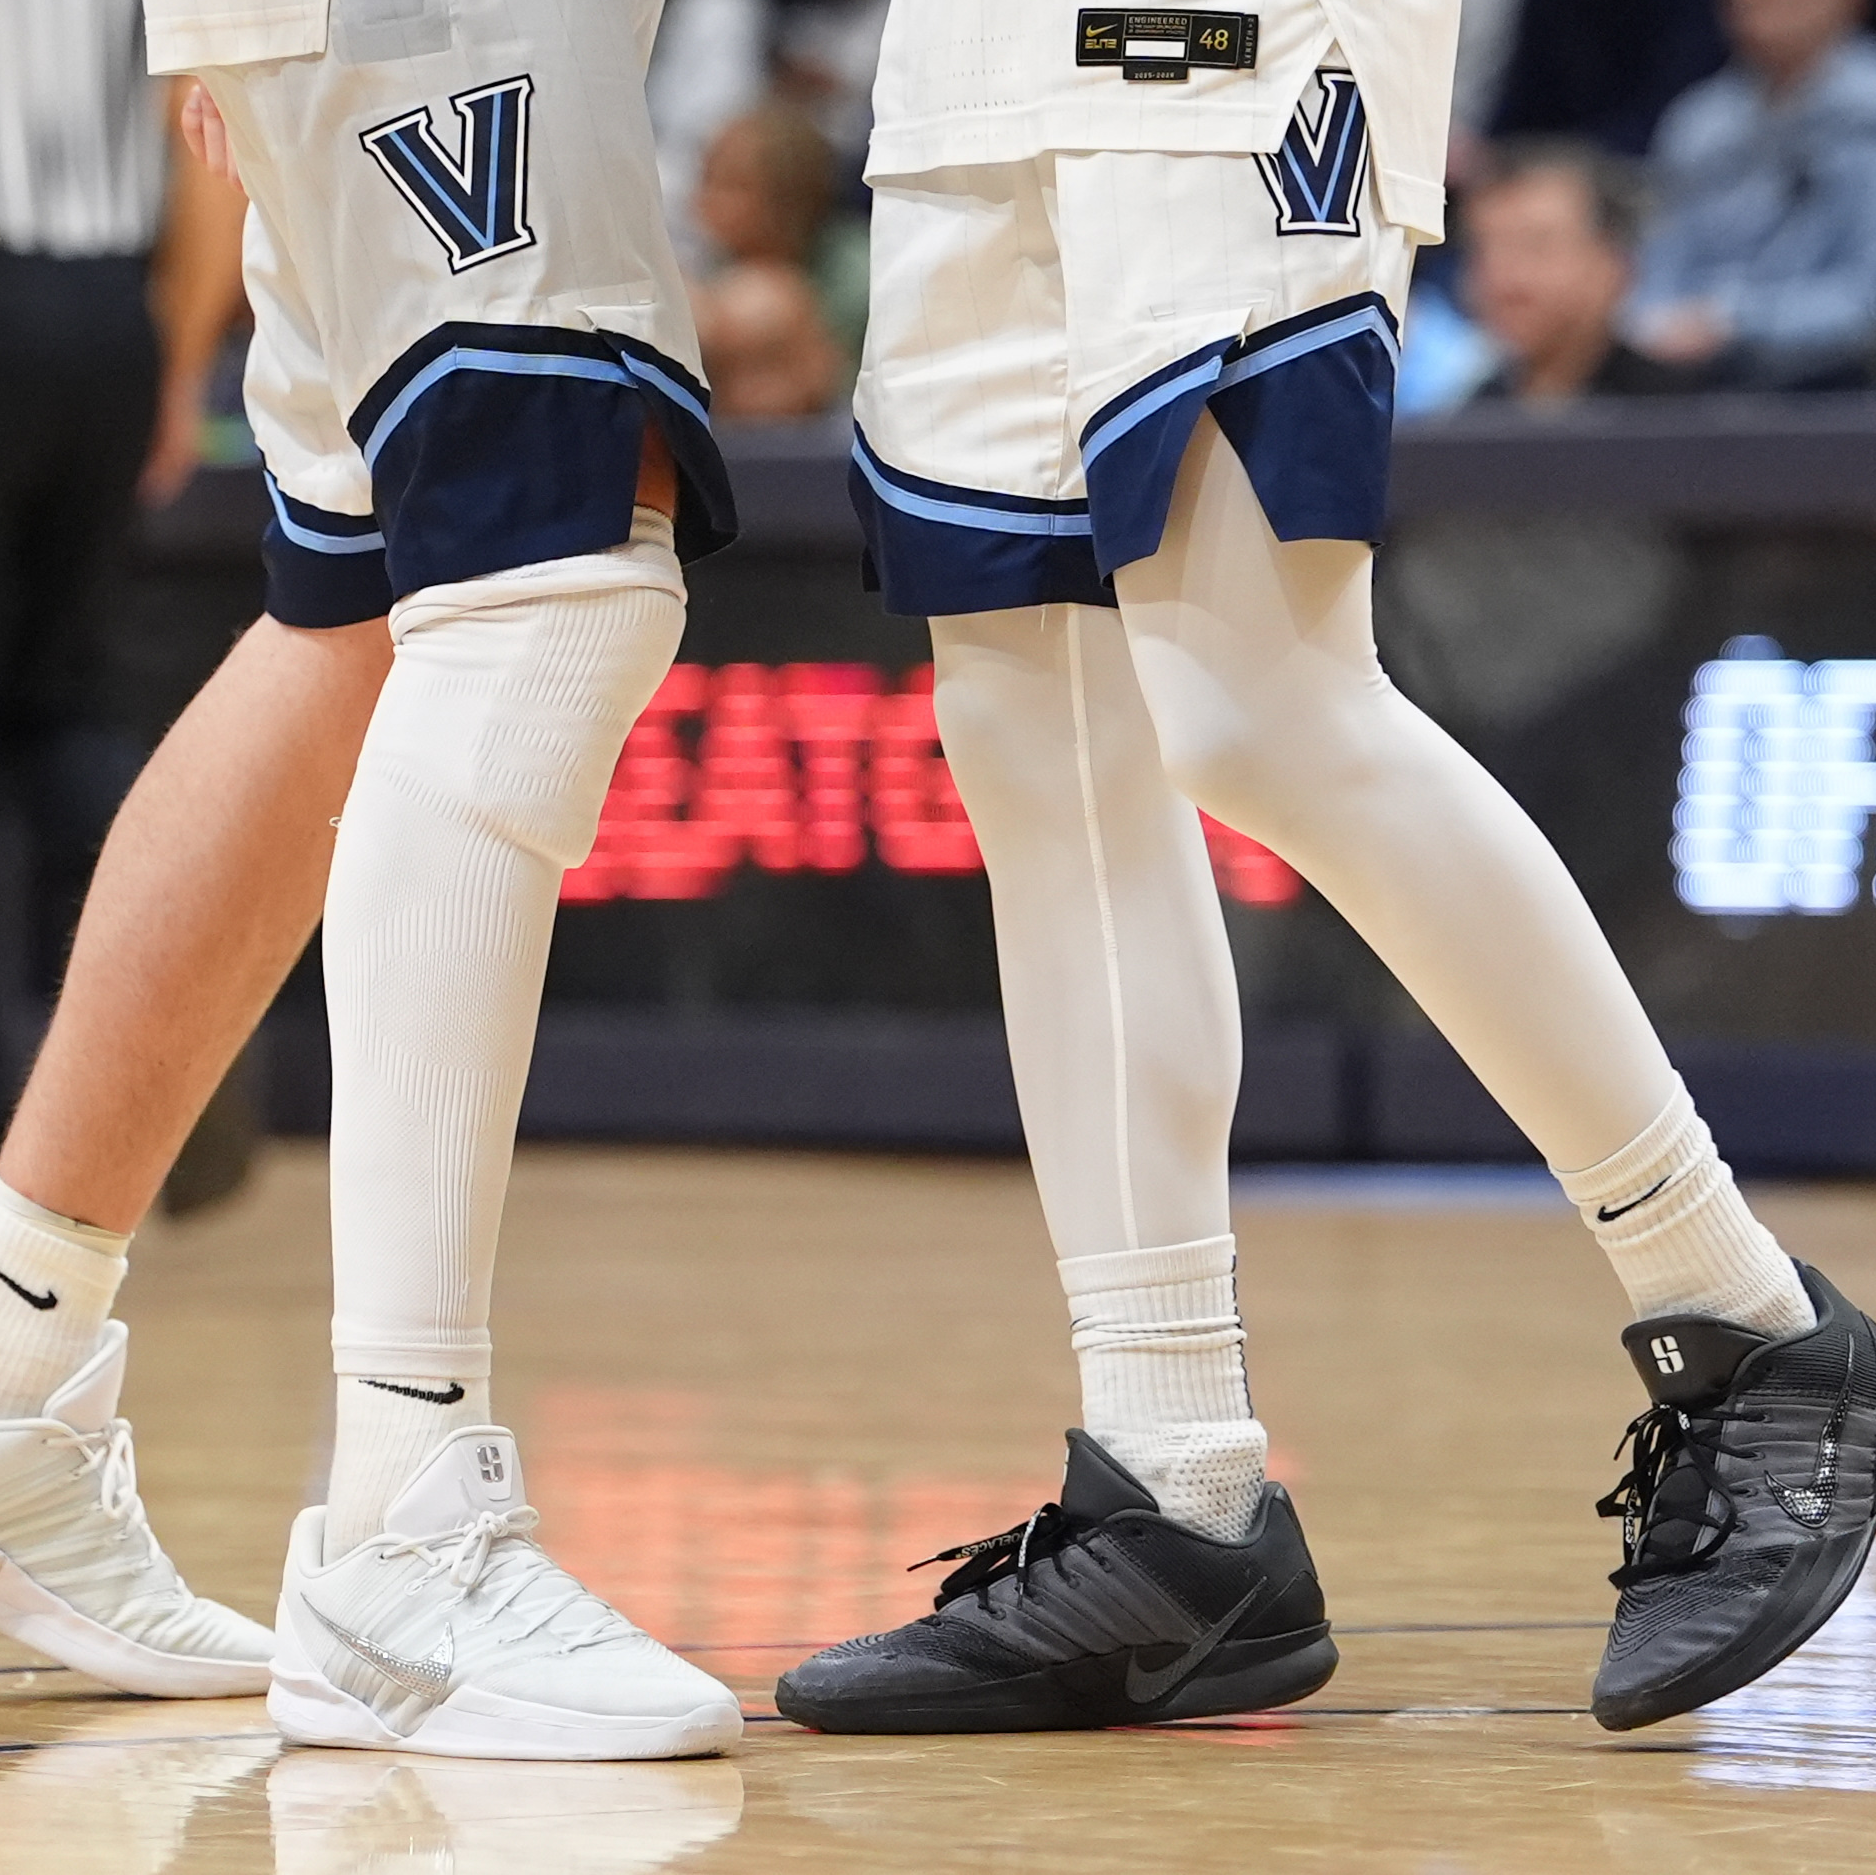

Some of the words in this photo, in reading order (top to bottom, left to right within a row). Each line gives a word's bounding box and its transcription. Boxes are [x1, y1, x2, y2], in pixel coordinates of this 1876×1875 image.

[1128, 15, 1188, 26] ENGINEERED
[1198, 28, 1229, 51] 48
[358, 73, 537, 276] V
